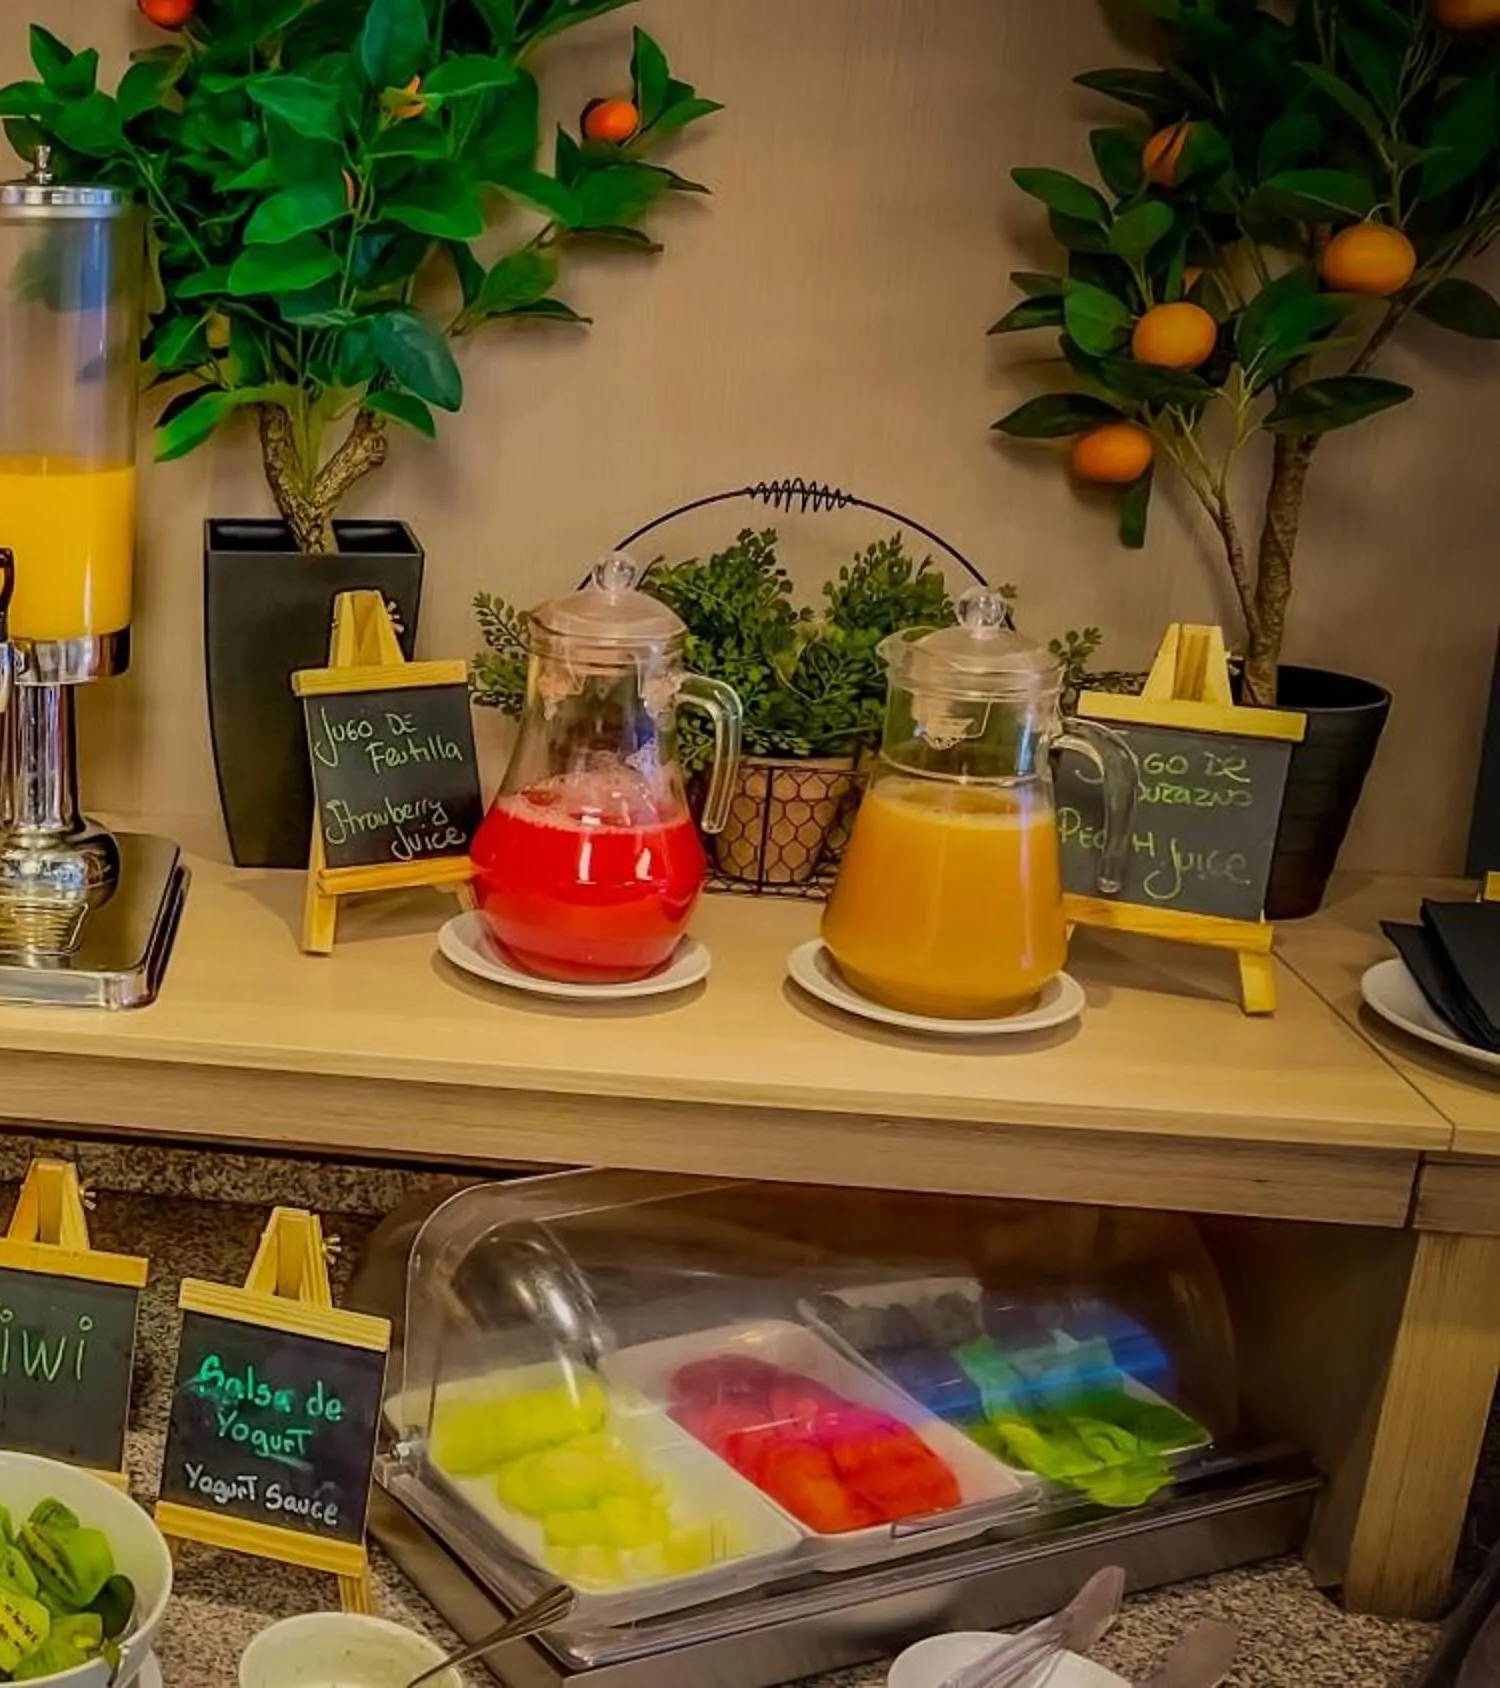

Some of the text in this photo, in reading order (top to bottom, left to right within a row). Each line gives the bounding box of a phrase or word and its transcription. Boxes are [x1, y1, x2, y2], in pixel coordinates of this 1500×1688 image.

[197, 1354, 342, 1421] Salsa de
[265, 1483, 339, 1526] Sauce
